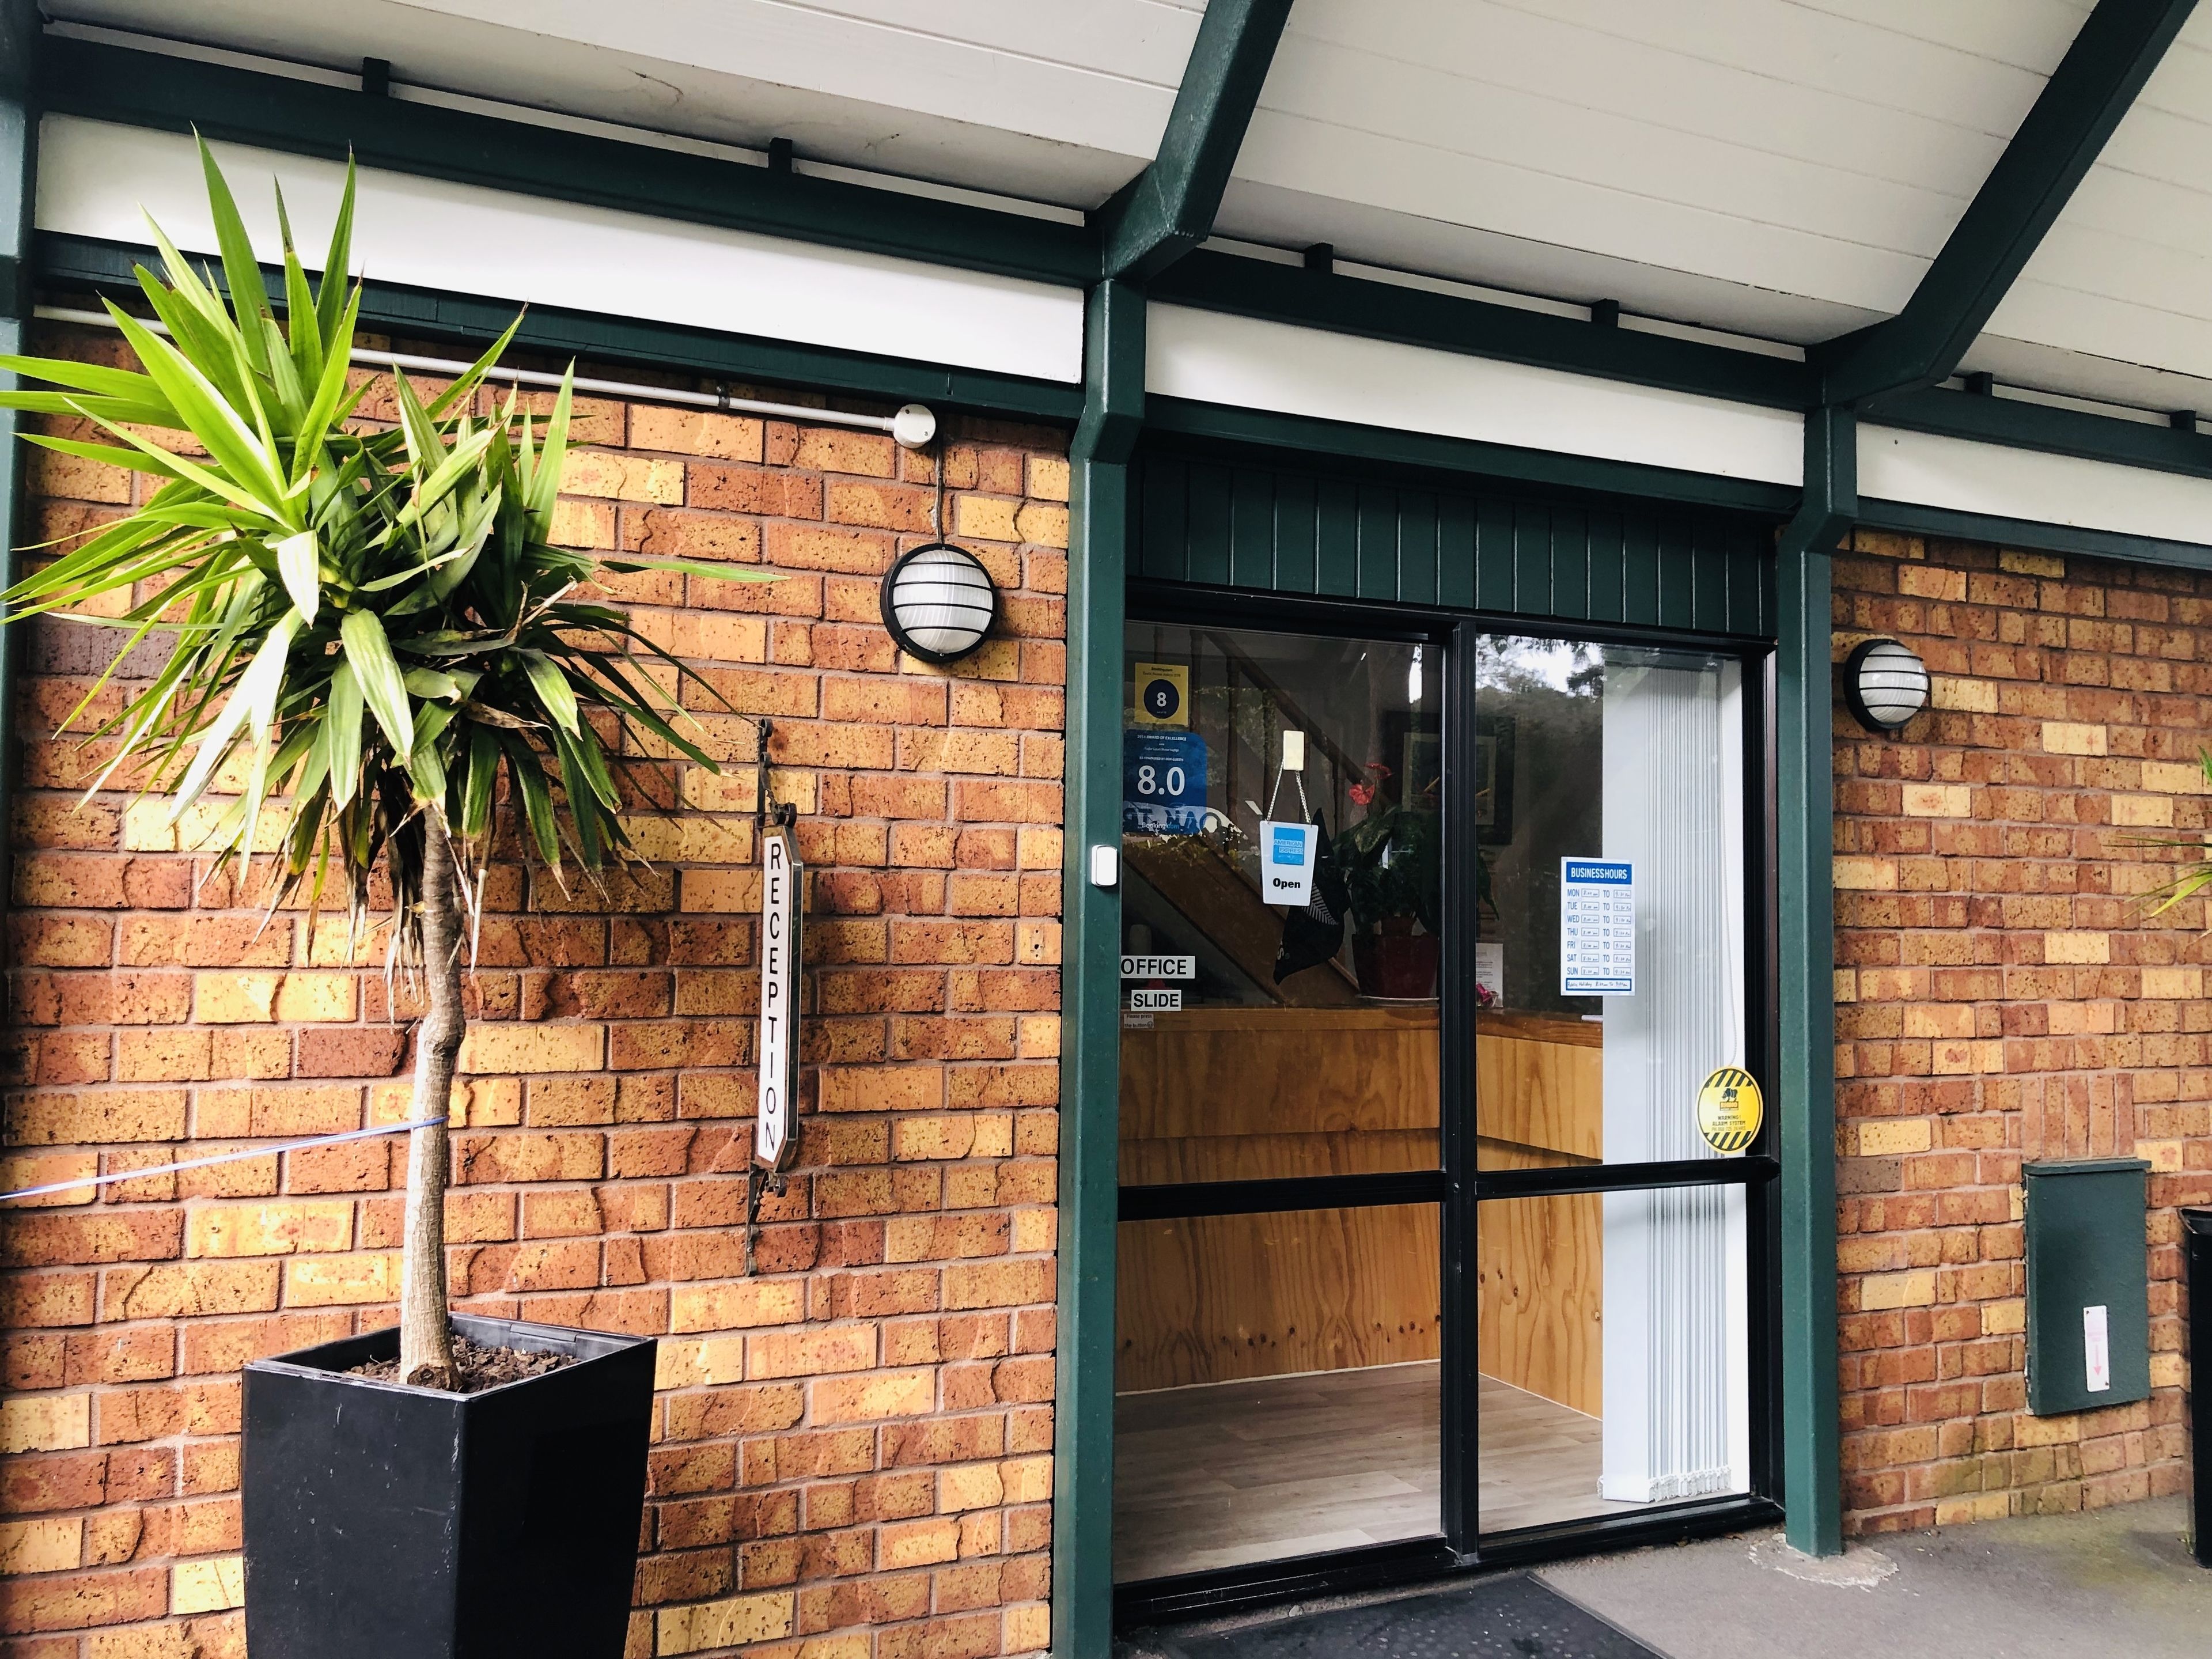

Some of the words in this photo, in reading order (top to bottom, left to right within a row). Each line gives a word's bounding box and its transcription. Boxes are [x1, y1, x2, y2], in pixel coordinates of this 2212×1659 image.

[1157, 692, 1166, 707] 8
[1137, 765, 1185, 796] 8.0
[1274, 839, 1302, 847] AMERICAN
[1571, 867, 1604, 879] BUSINESS
[1604, 869, 1627, 880] HOURS
[1272, 878, 1301, 889] Open
[1567, 902, 1577, 910] TUE
[1603, 929, 1610, 937] TO
[1567, 941, 1575, 949] FRI
[1603, 941, 1610, 949] TO
[1121, 958, 1187, 975] OFFICE
[766, 843, 781, 1152] RECEPTION
[1134, 993, 1179, 1007] SLIDE
